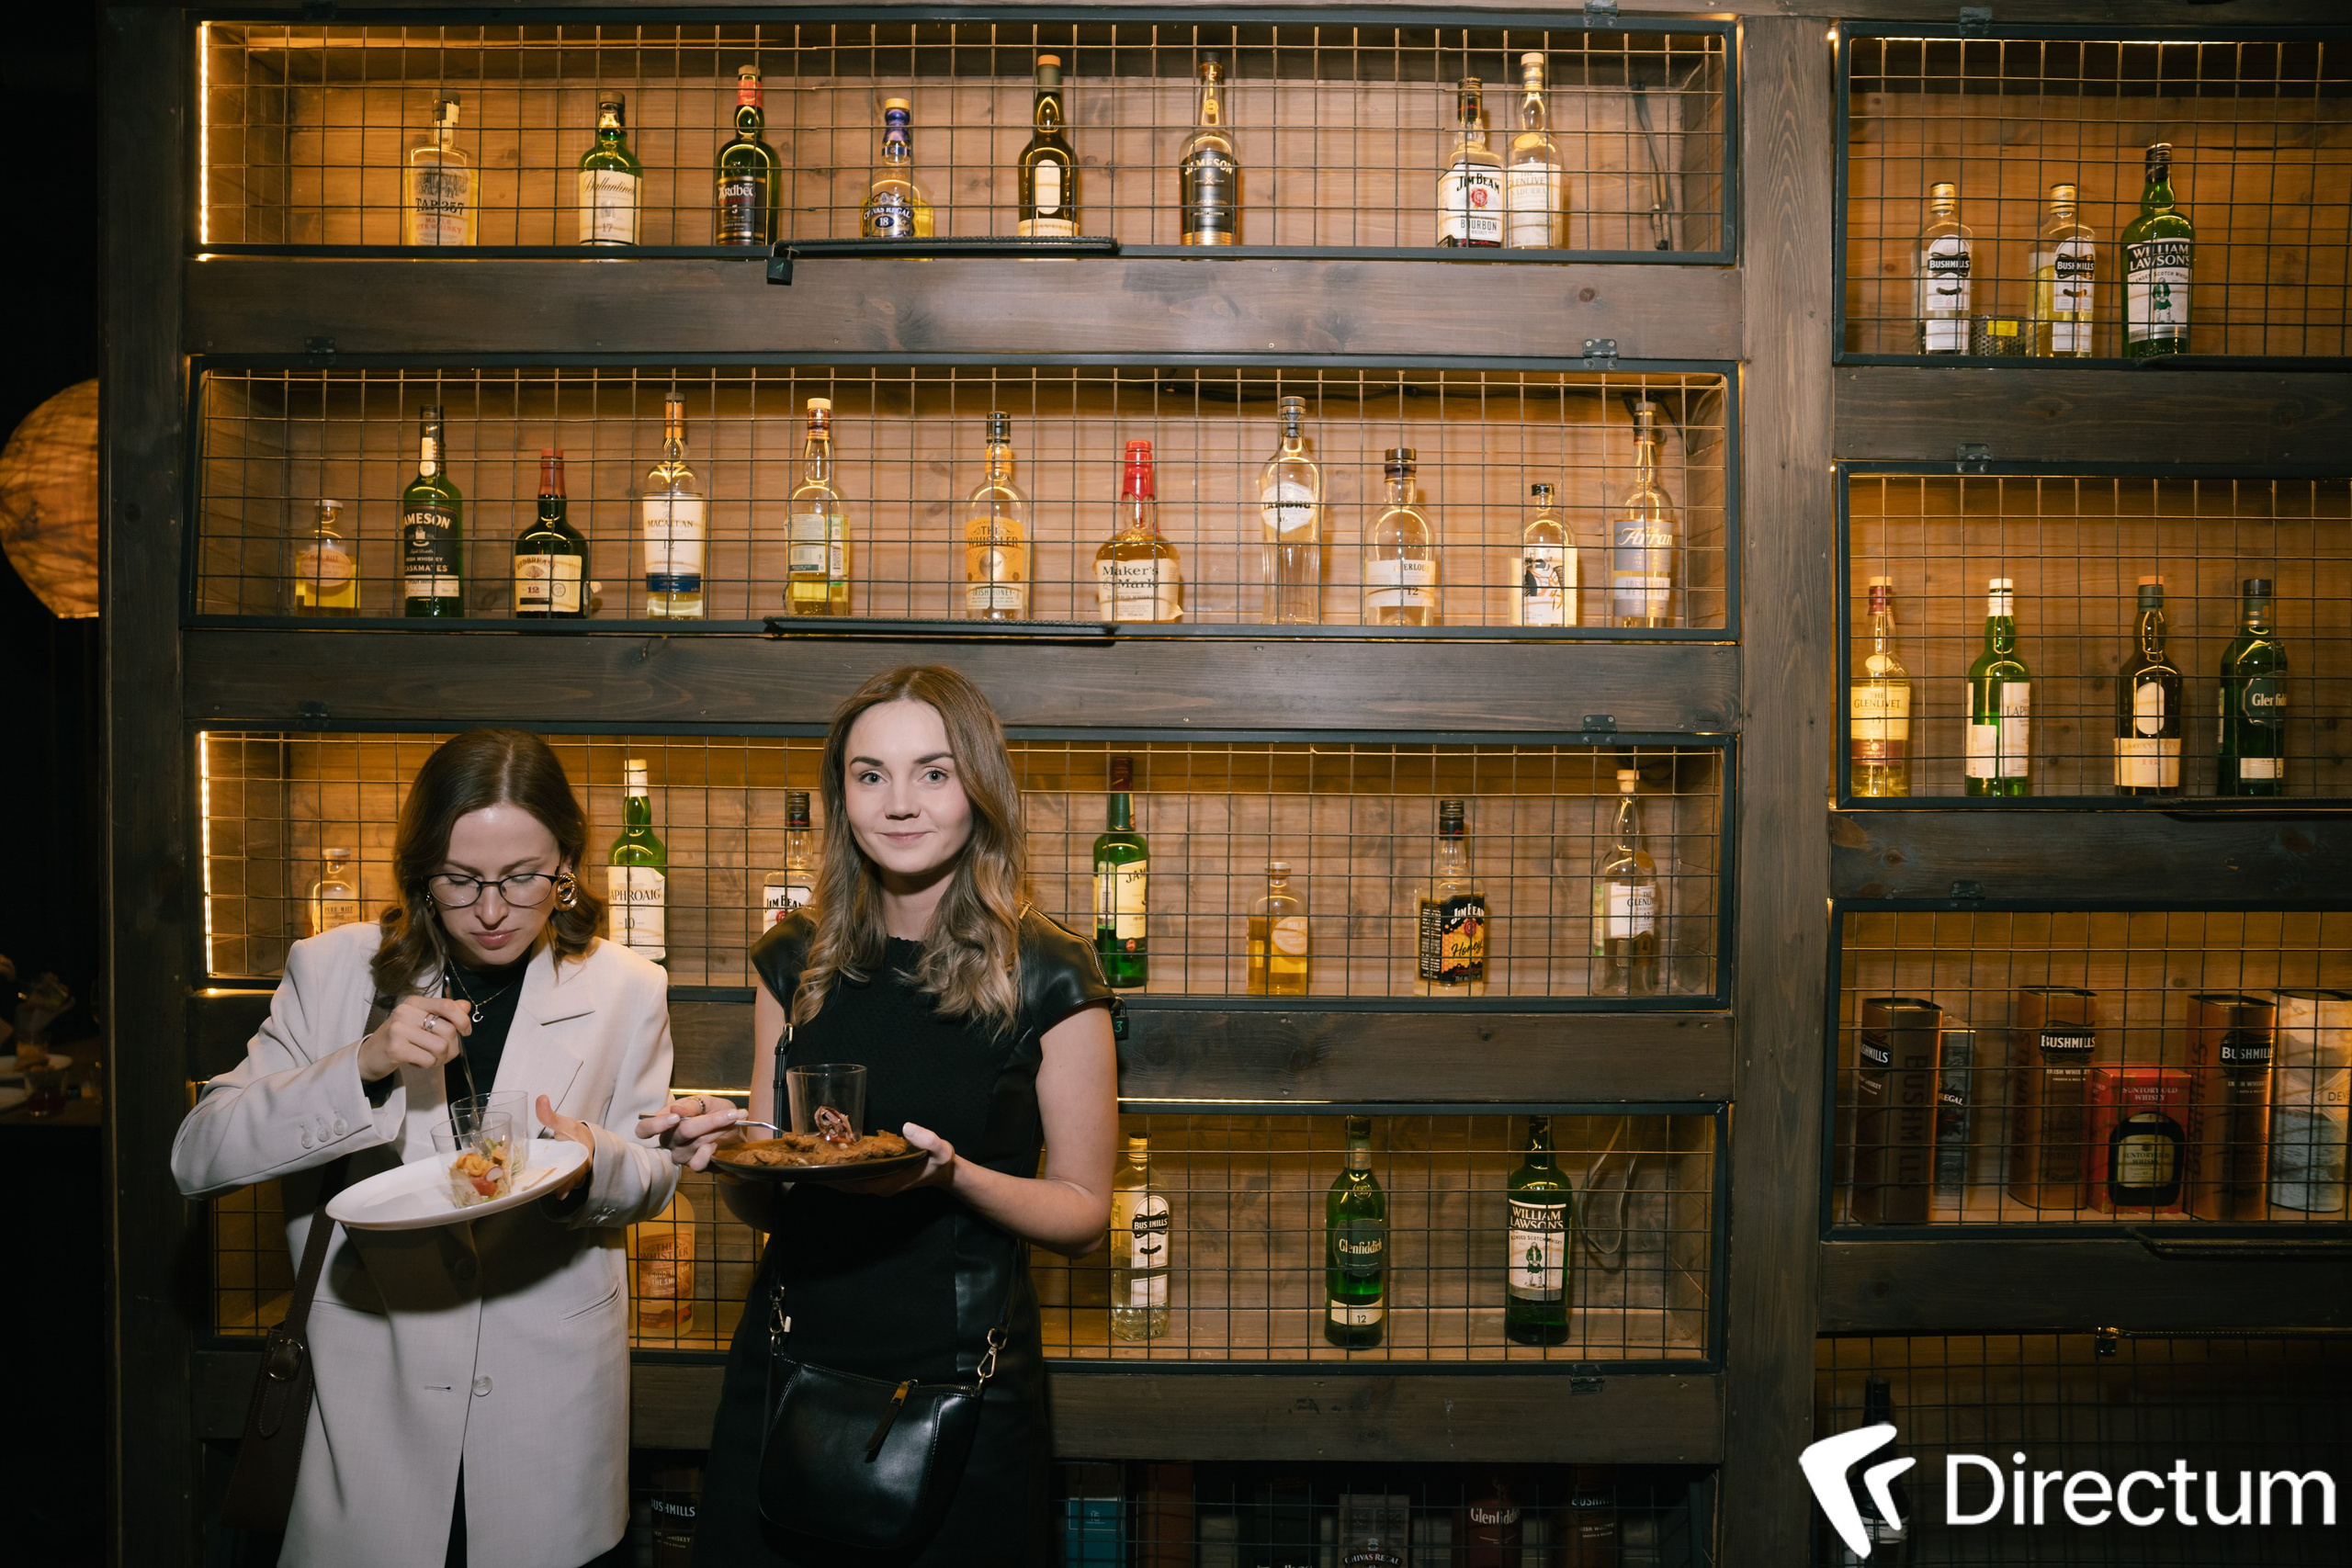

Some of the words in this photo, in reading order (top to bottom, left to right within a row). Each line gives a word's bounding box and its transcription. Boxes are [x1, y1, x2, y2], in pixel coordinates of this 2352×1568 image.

[415, 197, 439, 212] TAP
[440, 200, 465, 216] 357
[879, 216, 889, 226] 18
[1102, 566, 1159, 577] Maker's
[527, 586, 540, 594] 12
[1408, 587, 1419, 596] 12
[2041, 1034, 2096, 1049] BUSHMILLS
[1939, 1092, 1964, 1106] REGAL
[1512, 1205, 1561, 1221] WILLIAM
[1356, 1314, 1367, 1324] 12
